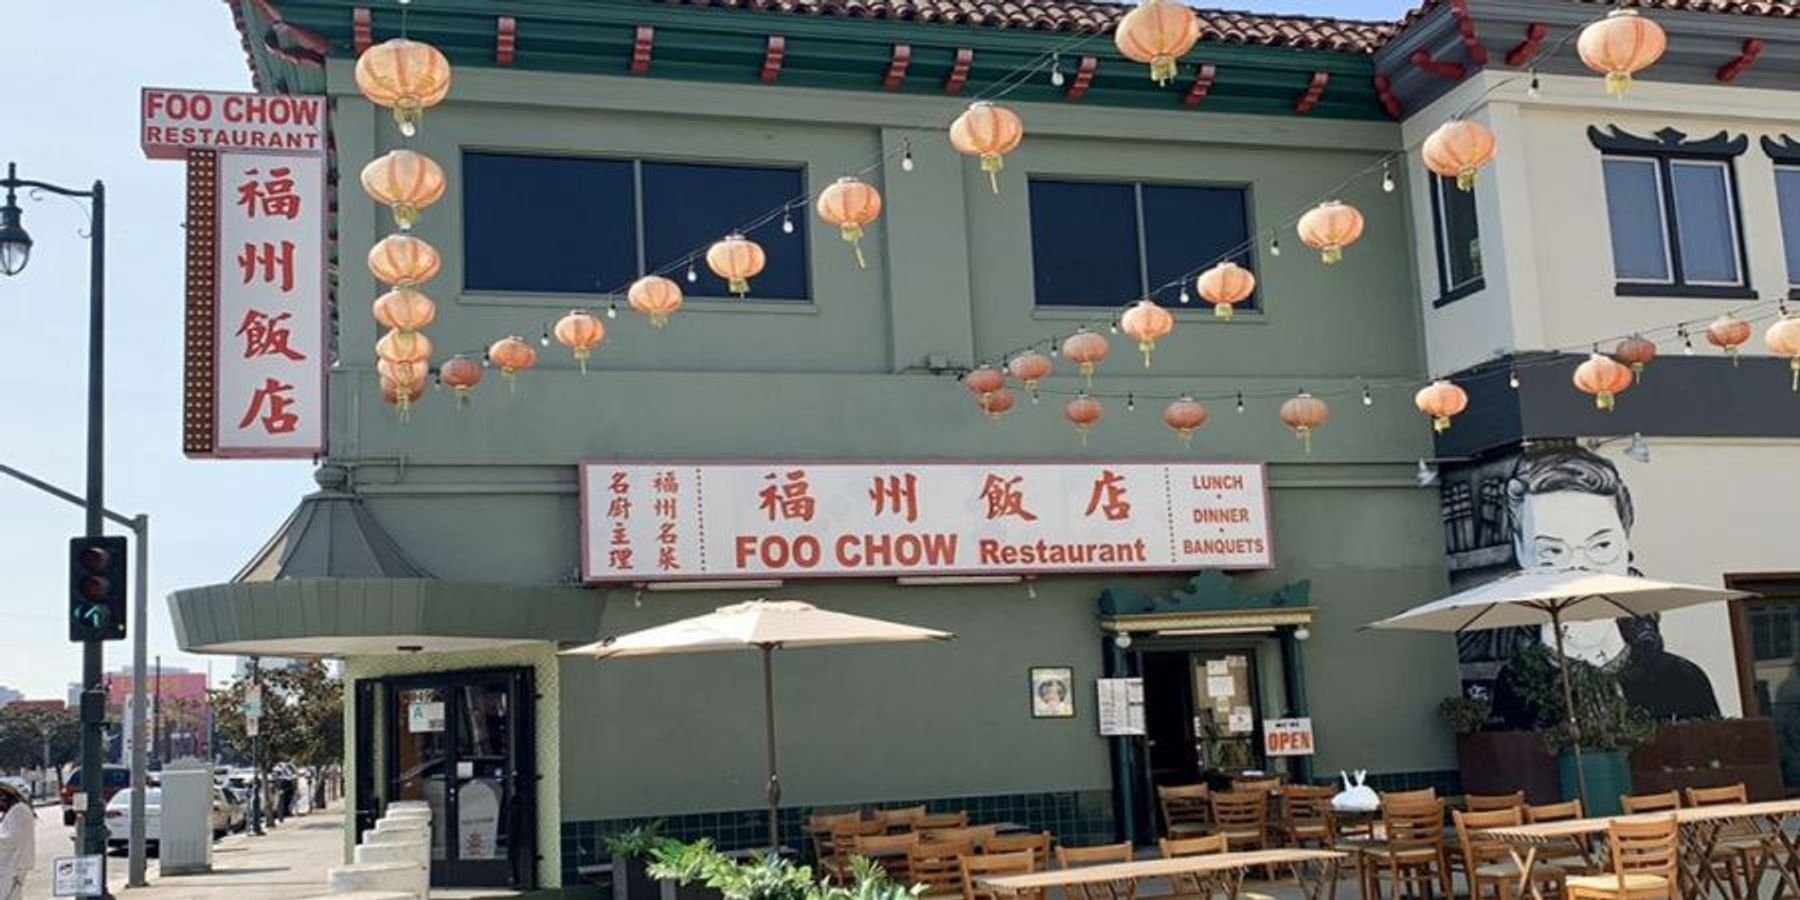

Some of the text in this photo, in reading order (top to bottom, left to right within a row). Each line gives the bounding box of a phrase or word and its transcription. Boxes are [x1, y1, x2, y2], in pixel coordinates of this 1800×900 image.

[146, 92, 318, 125] FOO CHOW
[147, 126, 318, 148] RESTAURANT
[235, 167, 306, 434] 福州飯店
[1192, 475, 1244, 490] LUNCH
[758, 469, 1131, 522] 福州飯店
[654, 471, 680, 571] 福州名菜
[1193, 507, 1249, 523] DINNER
[736, 533, 1146, 569] FOO CHOW Restaurant
[1183, 538, 1264, 555] BANQUETS
[414, 705, 425, 720] A
[1268, 731, 1312, 752] OPEN
